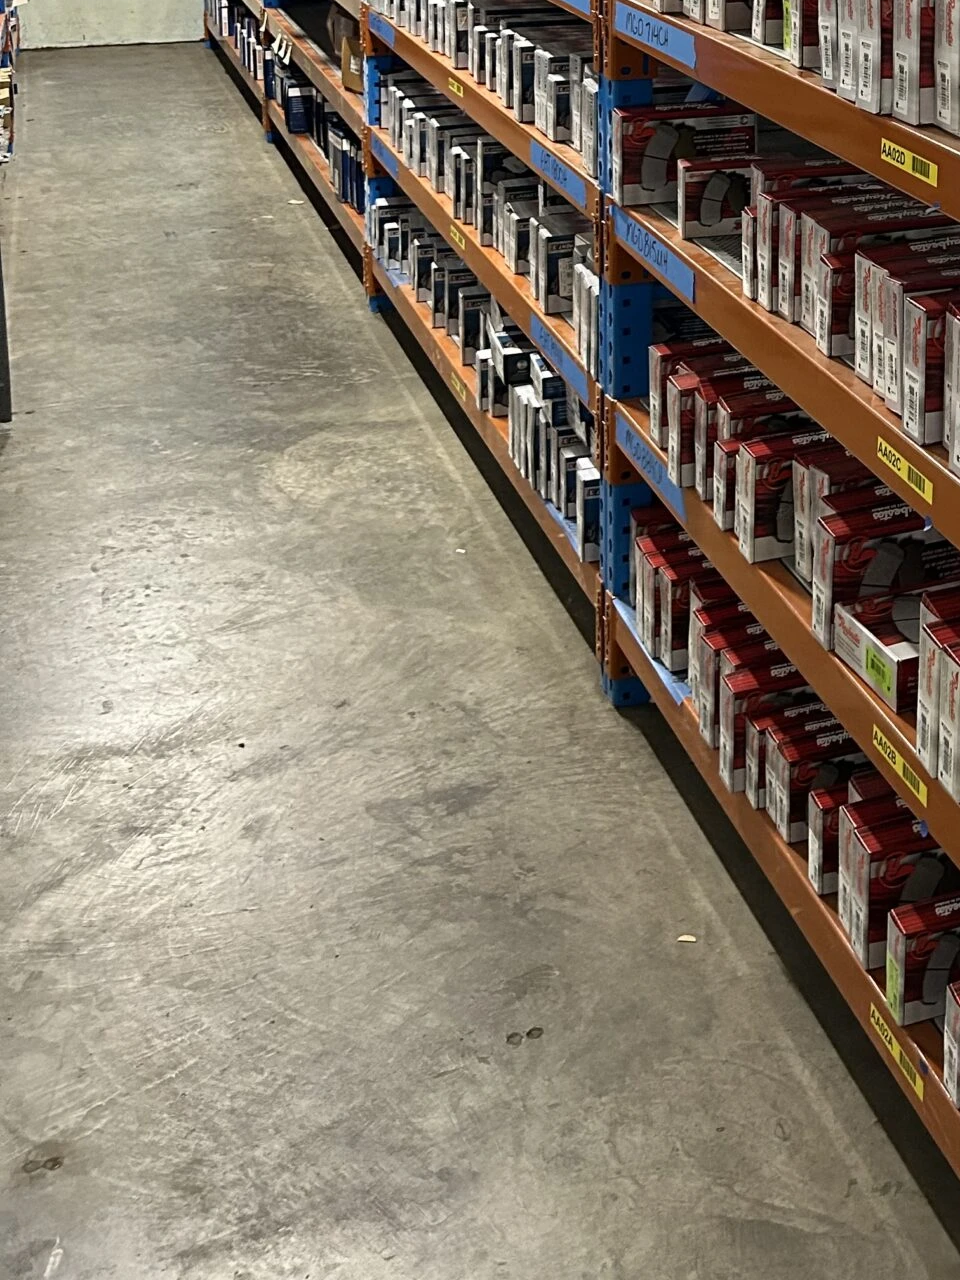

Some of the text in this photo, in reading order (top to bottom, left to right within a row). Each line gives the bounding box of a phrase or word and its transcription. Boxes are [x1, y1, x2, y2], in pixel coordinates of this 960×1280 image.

[881, 141, 906, 166] AA02D
[877, 440, 902, 472] AA02C
[873, 729, 897, 766] AA02B
[870, 1006, 896, 1051] AA02A
